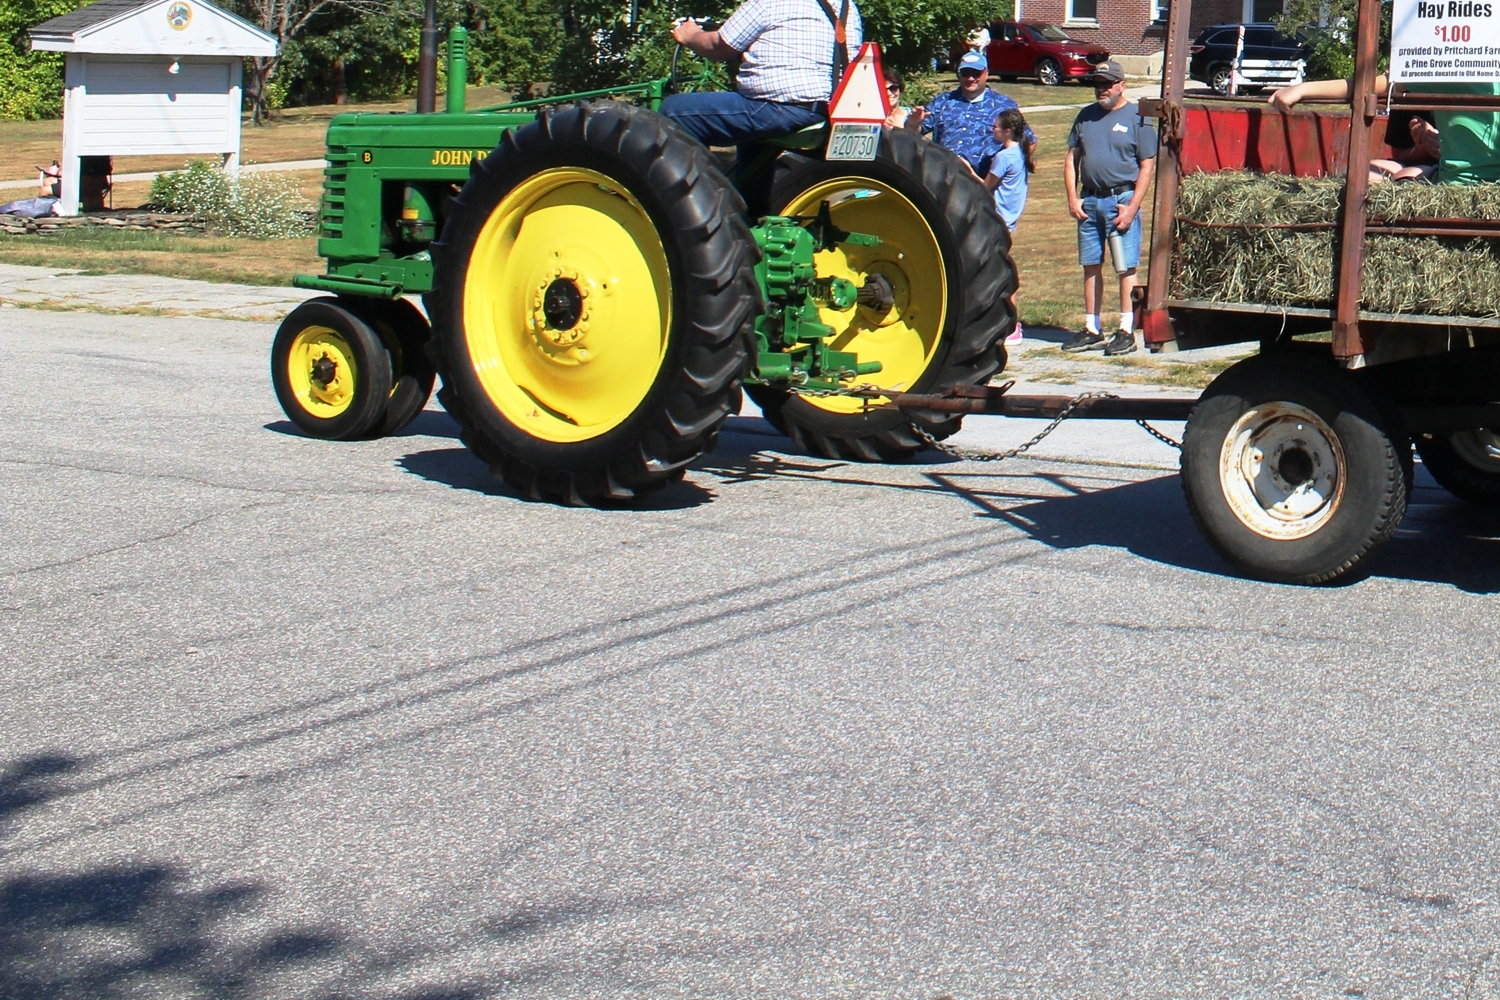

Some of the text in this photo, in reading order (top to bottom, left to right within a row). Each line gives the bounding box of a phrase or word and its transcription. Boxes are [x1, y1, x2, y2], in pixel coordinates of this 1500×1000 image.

[1418, 0, 1492, 19] Hay Rides
[1434, 25, 1471, 43] $1.00
[1399, 46, 1431, 56] provided
[1433, 46, 1443, 56] by
[1444, 46, 1483, 55] Pritchard
[1404, 60, 1410, 68] &
[1411, 59, 1428, 68] Pine
[1430, 59, 1453, 68] Grove
[364, 152, 371, 162] B
[432, 150, 472, 166] JOHN
